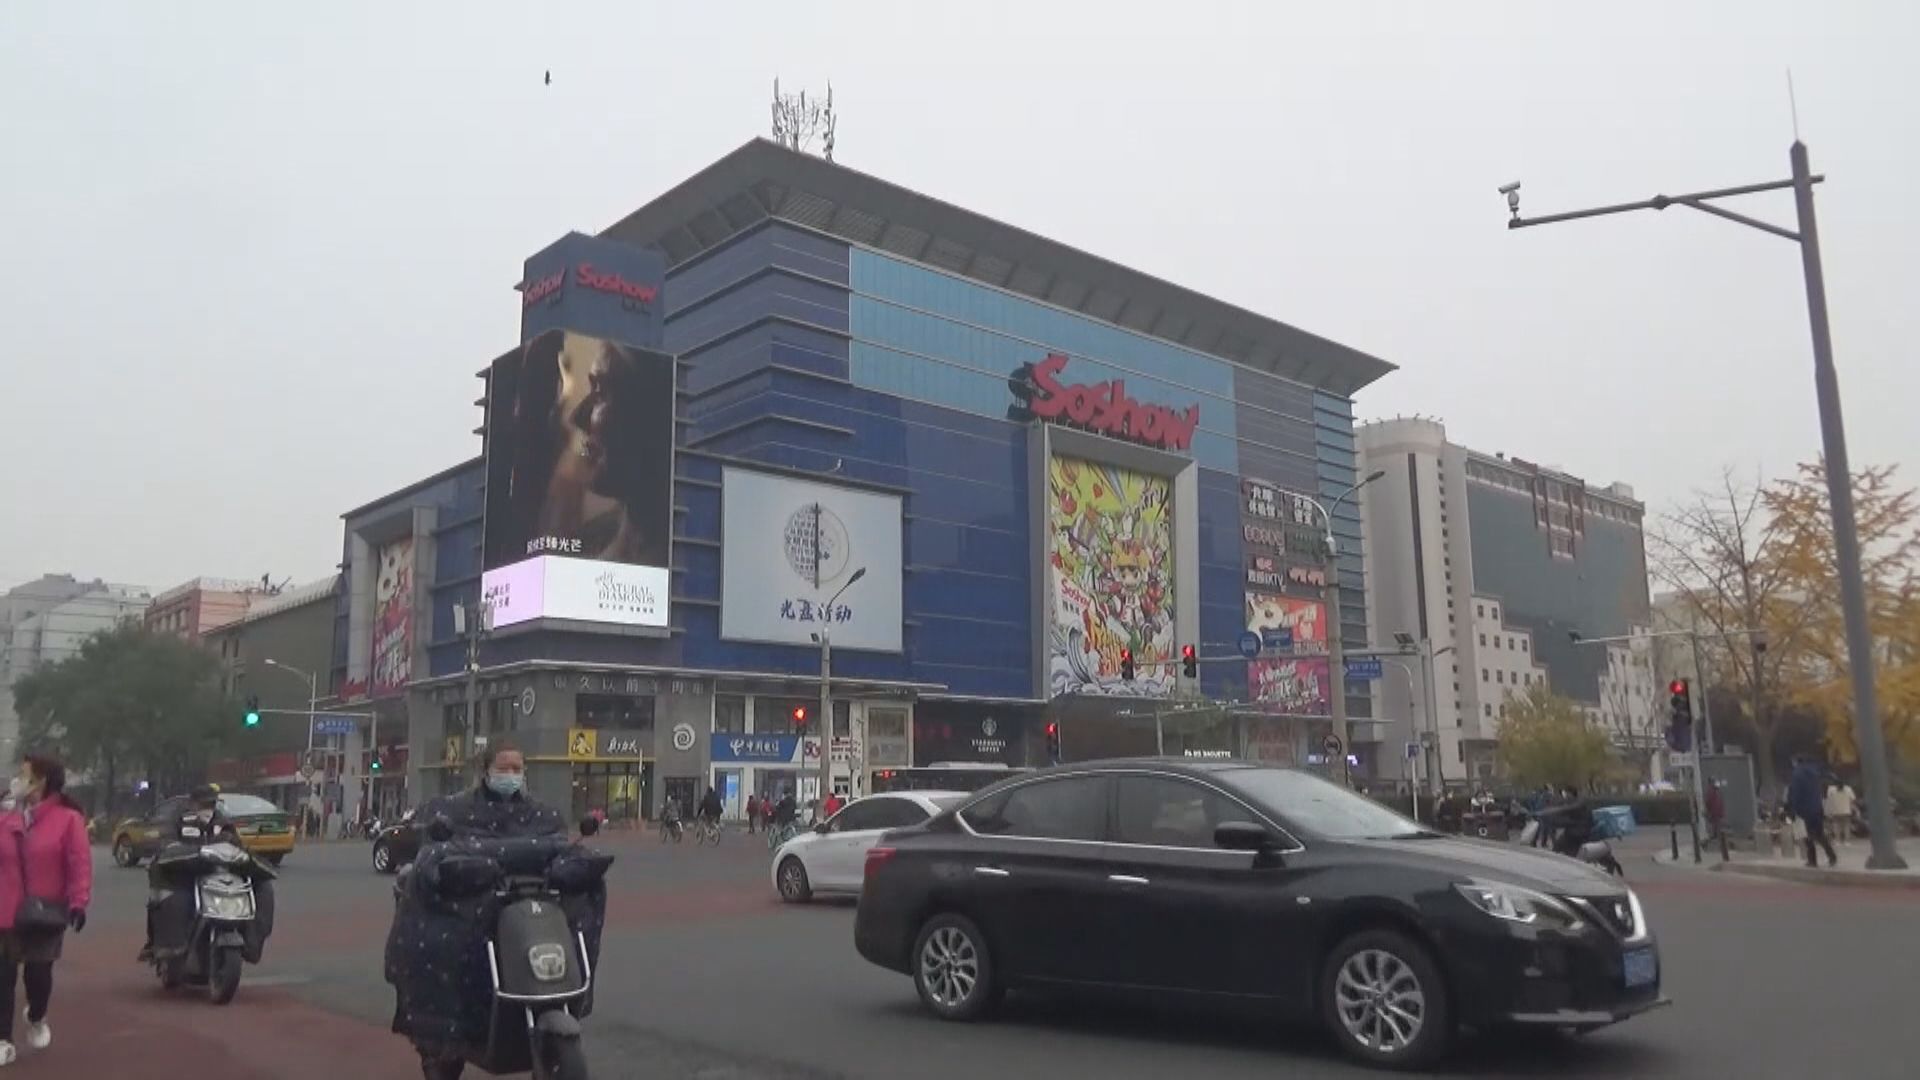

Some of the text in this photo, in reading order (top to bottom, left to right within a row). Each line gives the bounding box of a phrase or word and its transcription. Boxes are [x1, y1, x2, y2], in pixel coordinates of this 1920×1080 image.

[576, 262, 658, 304] Soshow
[1030, 353, 1199, 449] Soshow
[598, 592, 655, 605] DIAMONDS
[971, 739, 1006, 747] STARBUCKS
